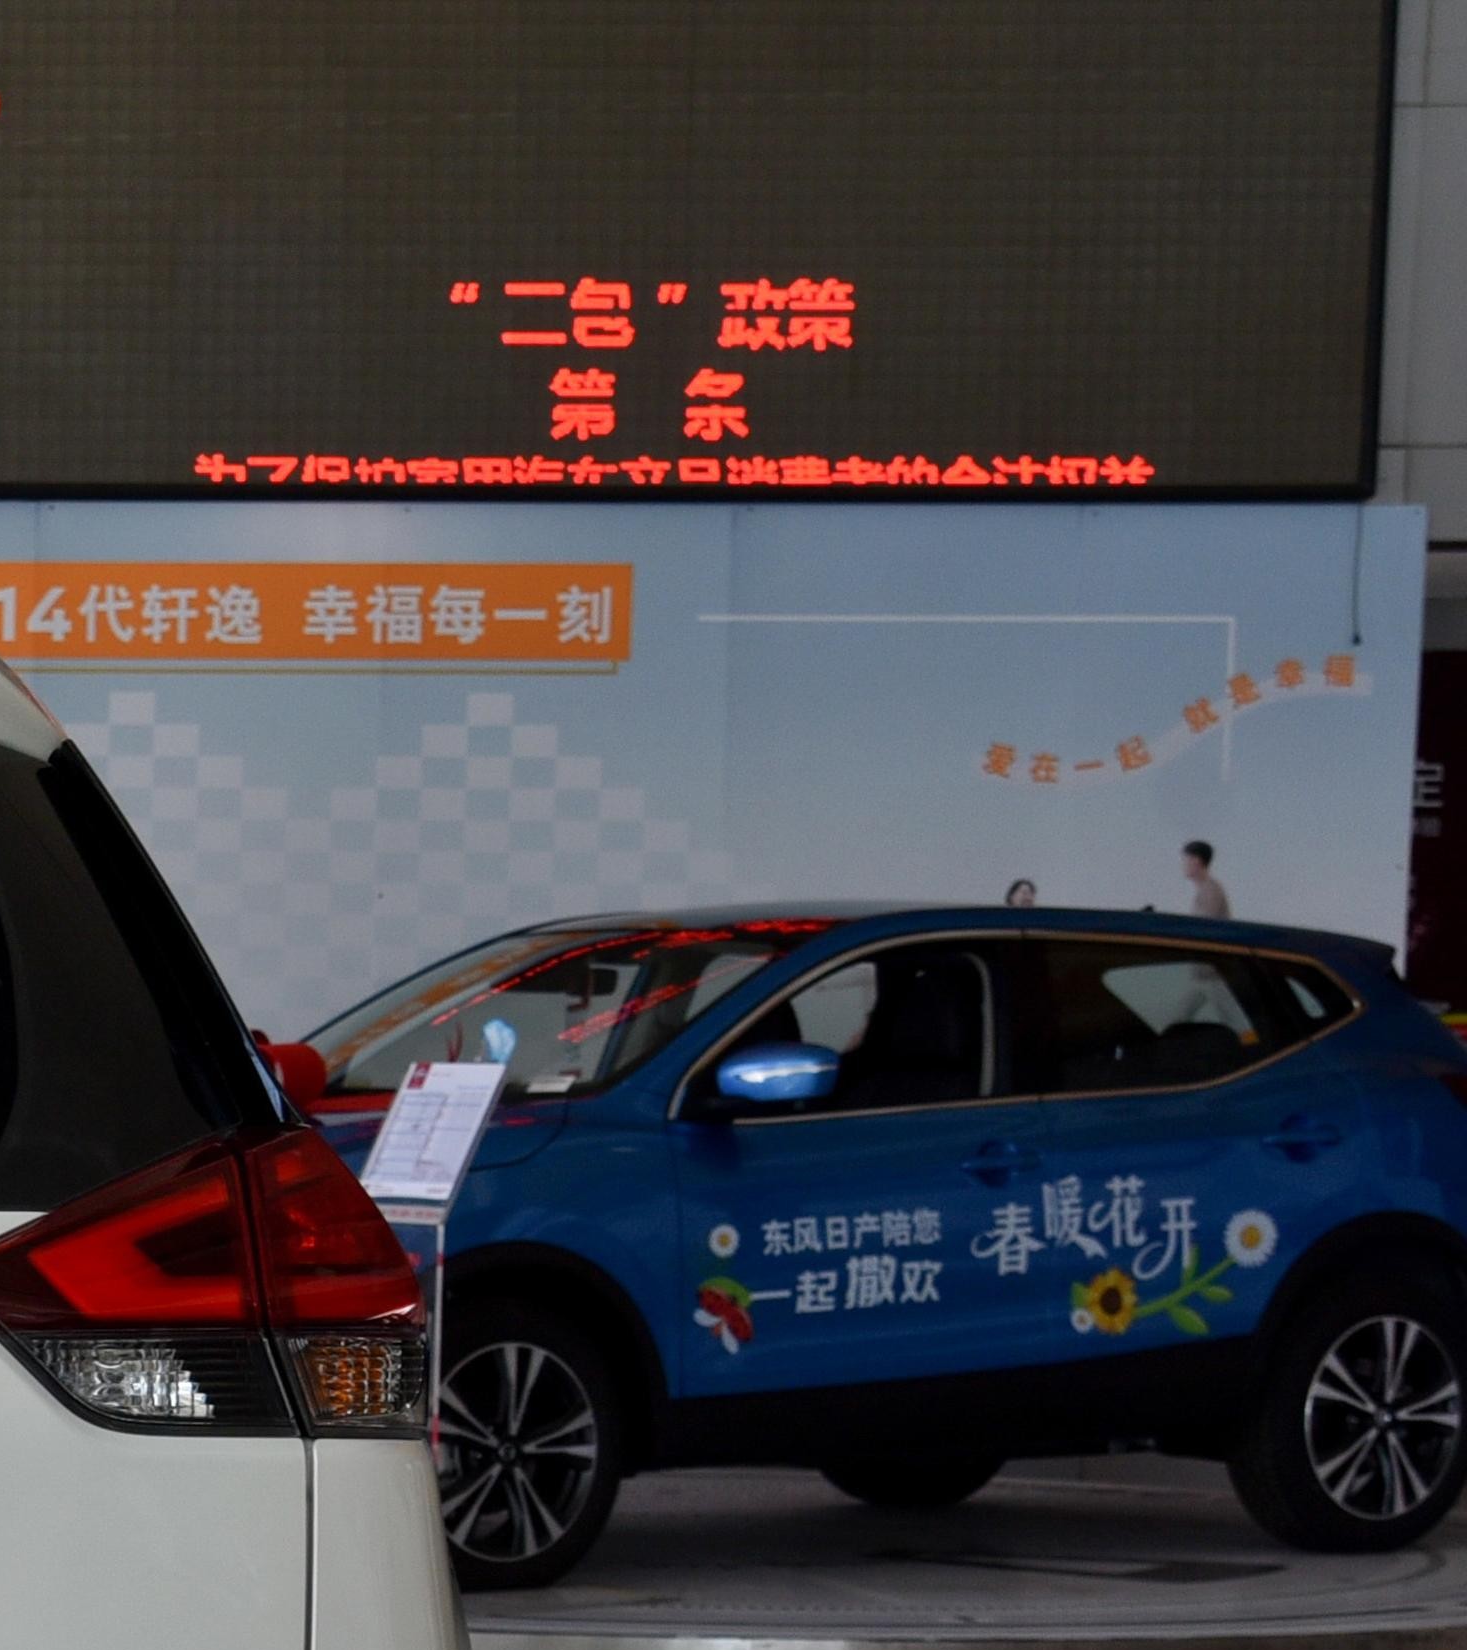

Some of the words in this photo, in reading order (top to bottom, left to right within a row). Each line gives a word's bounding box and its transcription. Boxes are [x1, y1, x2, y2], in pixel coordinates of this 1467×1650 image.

[302, 583, 614, 645] 幸福每一刻
[761, 1207, 943, 1257] 东风日产陪您
[971, 1174, 1197, 1281] 春暖花开
[751, 1253, 943, 1314] 一起撒欢
